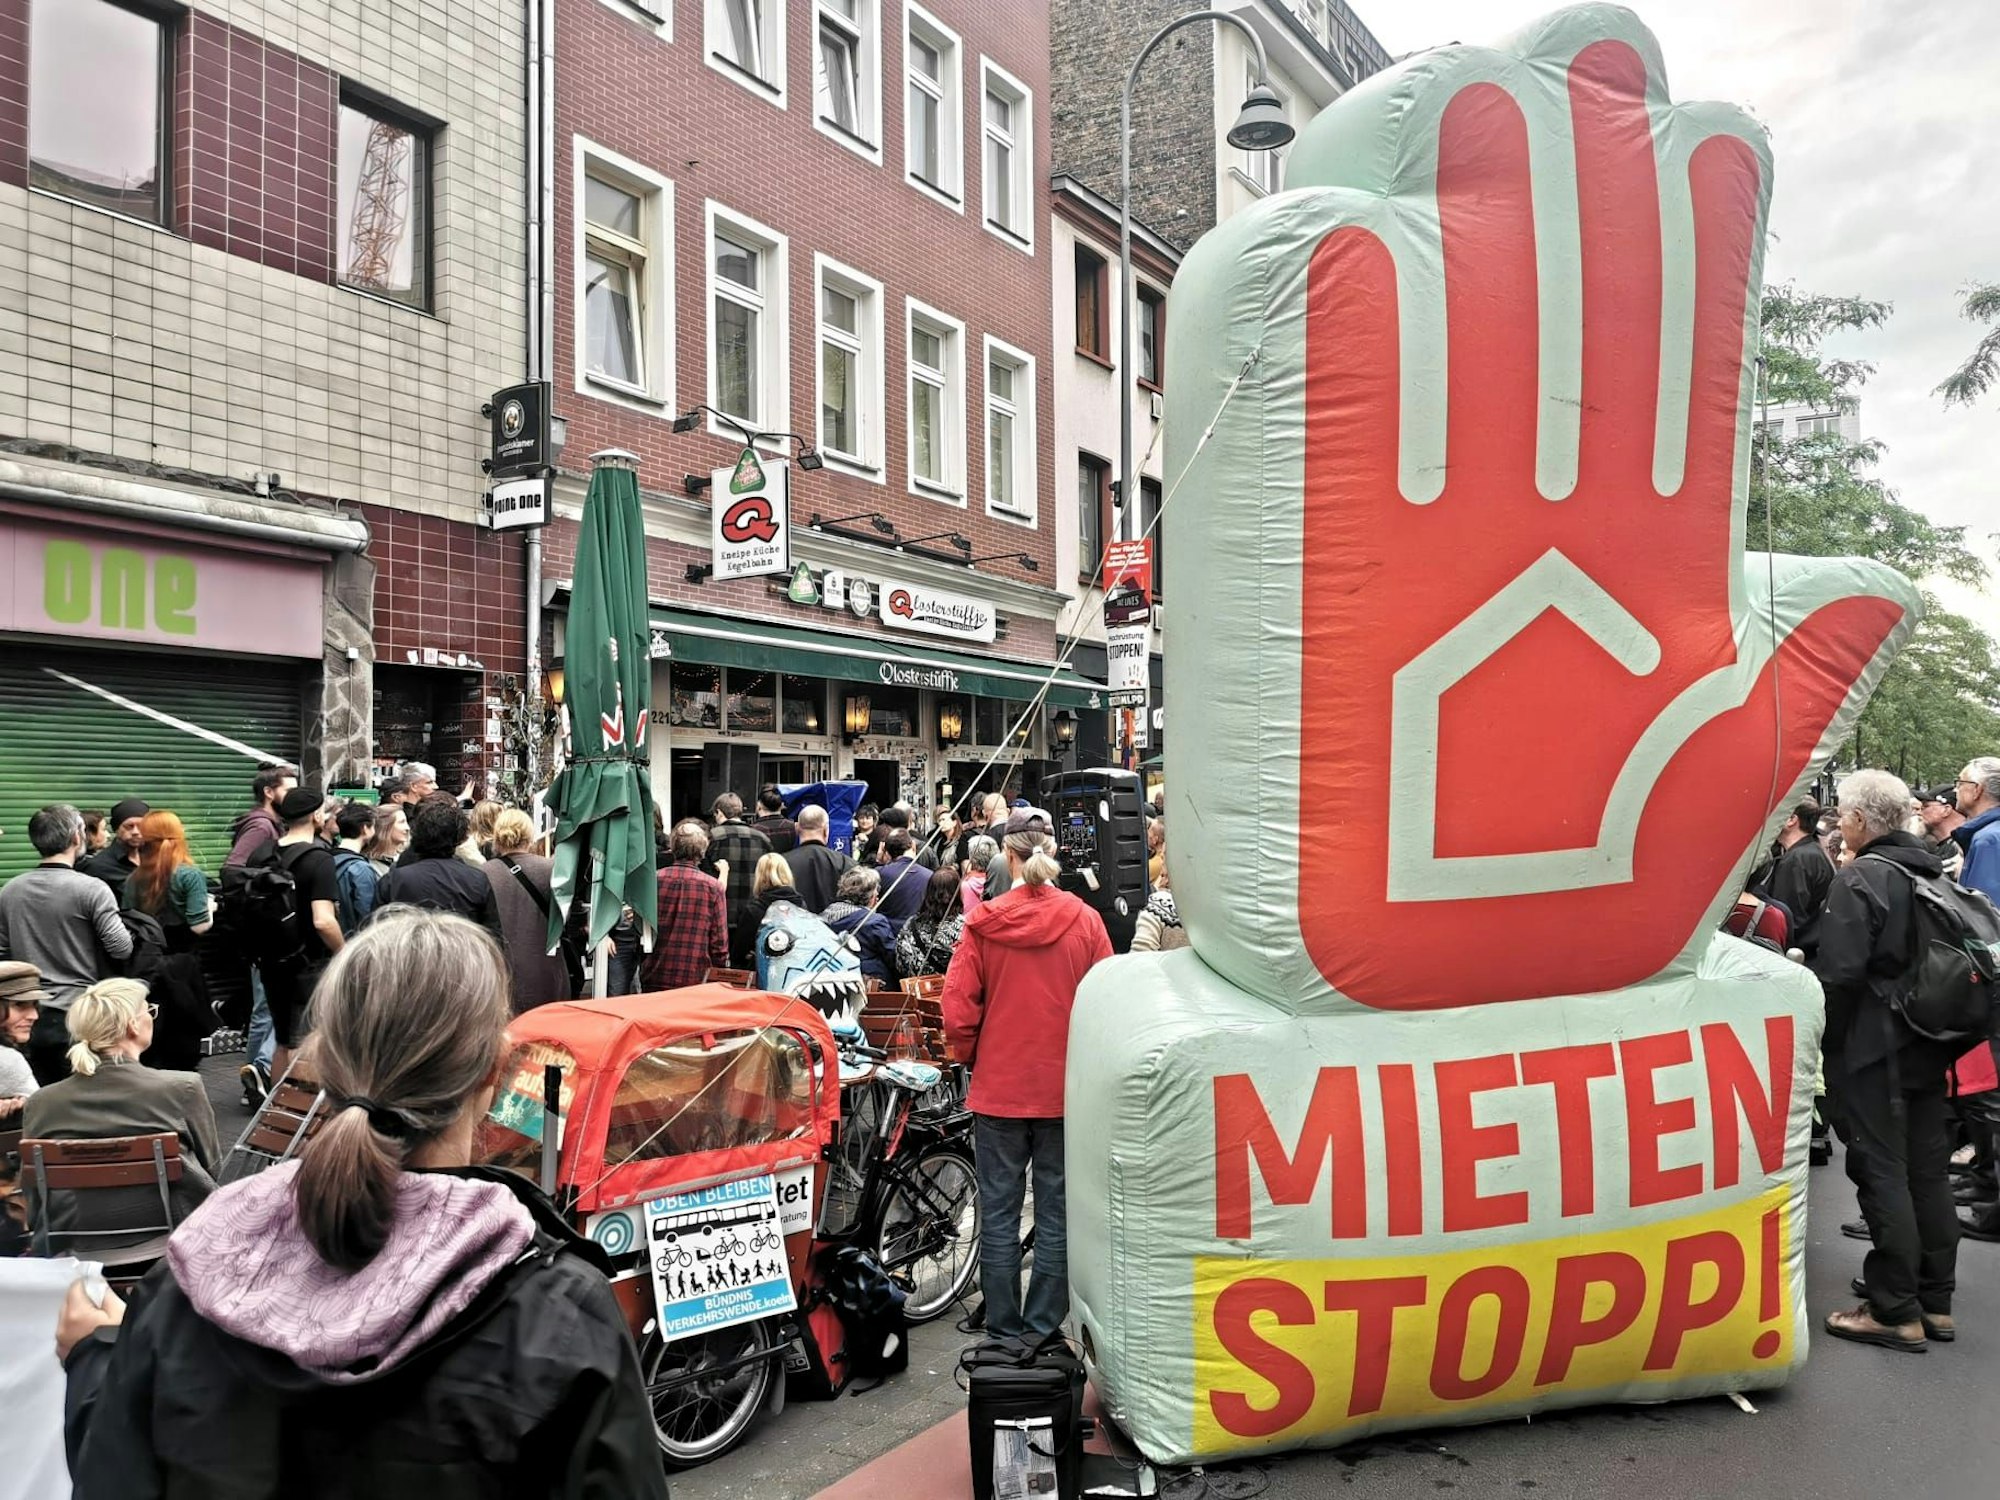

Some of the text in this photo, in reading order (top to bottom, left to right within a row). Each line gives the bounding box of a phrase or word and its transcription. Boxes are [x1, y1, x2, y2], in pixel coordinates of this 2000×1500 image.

[721, 545, 780, 560] Kneipe Küche
[727, 558, 773, 572] Kegelbahn
[1109, 642, 1144, 660] STOPPEN!
[1121, 694, 1144, 704] MLPD
[651, 711, 670, 724] 221
[1213, 1014, 1795, 1240] MIETEN
[652, 1175, 771, 1212] OBEN BLEIBEN
[704, 1289, 753, 1310] BÜNDNIS
[667, 1293, 793, 1332] VERKEHRSWENDE.koeln
[1208, 1207, 1783, 1437] STOPP!
